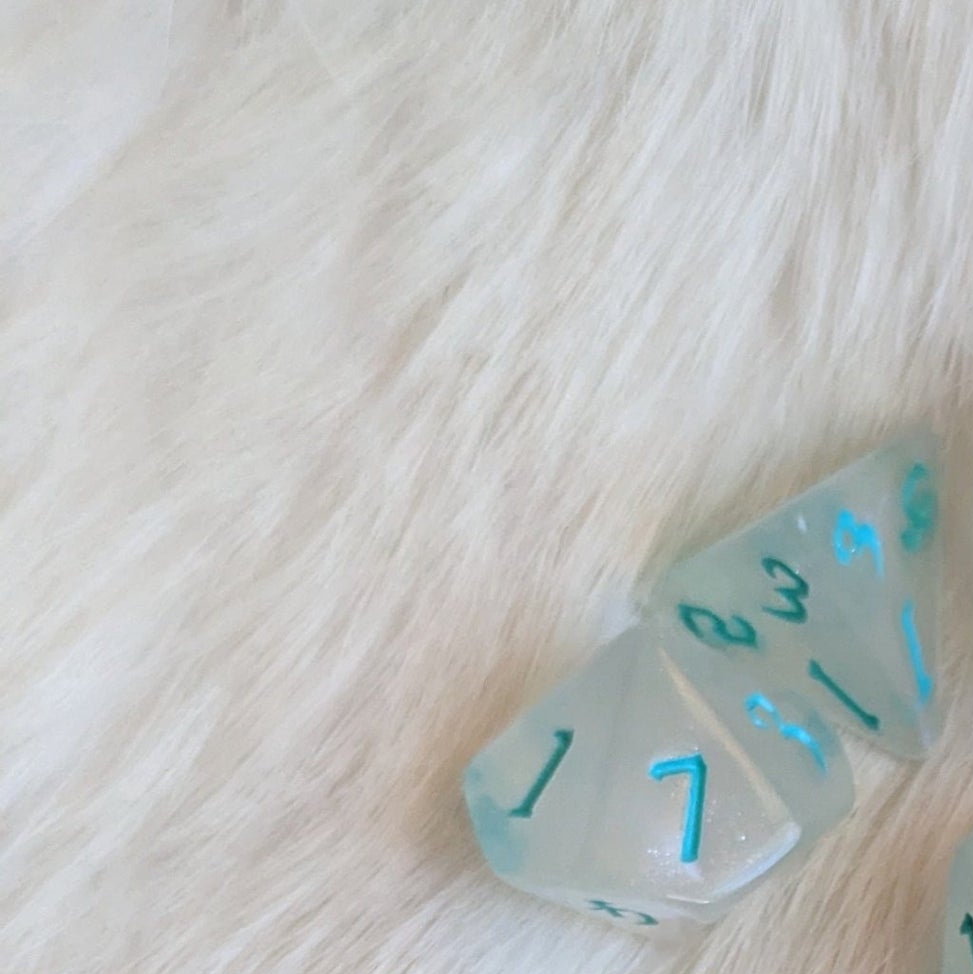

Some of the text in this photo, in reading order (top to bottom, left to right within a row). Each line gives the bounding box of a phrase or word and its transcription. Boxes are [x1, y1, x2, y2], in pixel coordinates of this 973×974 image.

[759, 553, 810, 624] 3
[807, 659, 880, 742] 1
[506, 727, 575, 819] 1
[646, 751, 709, 865] 7
